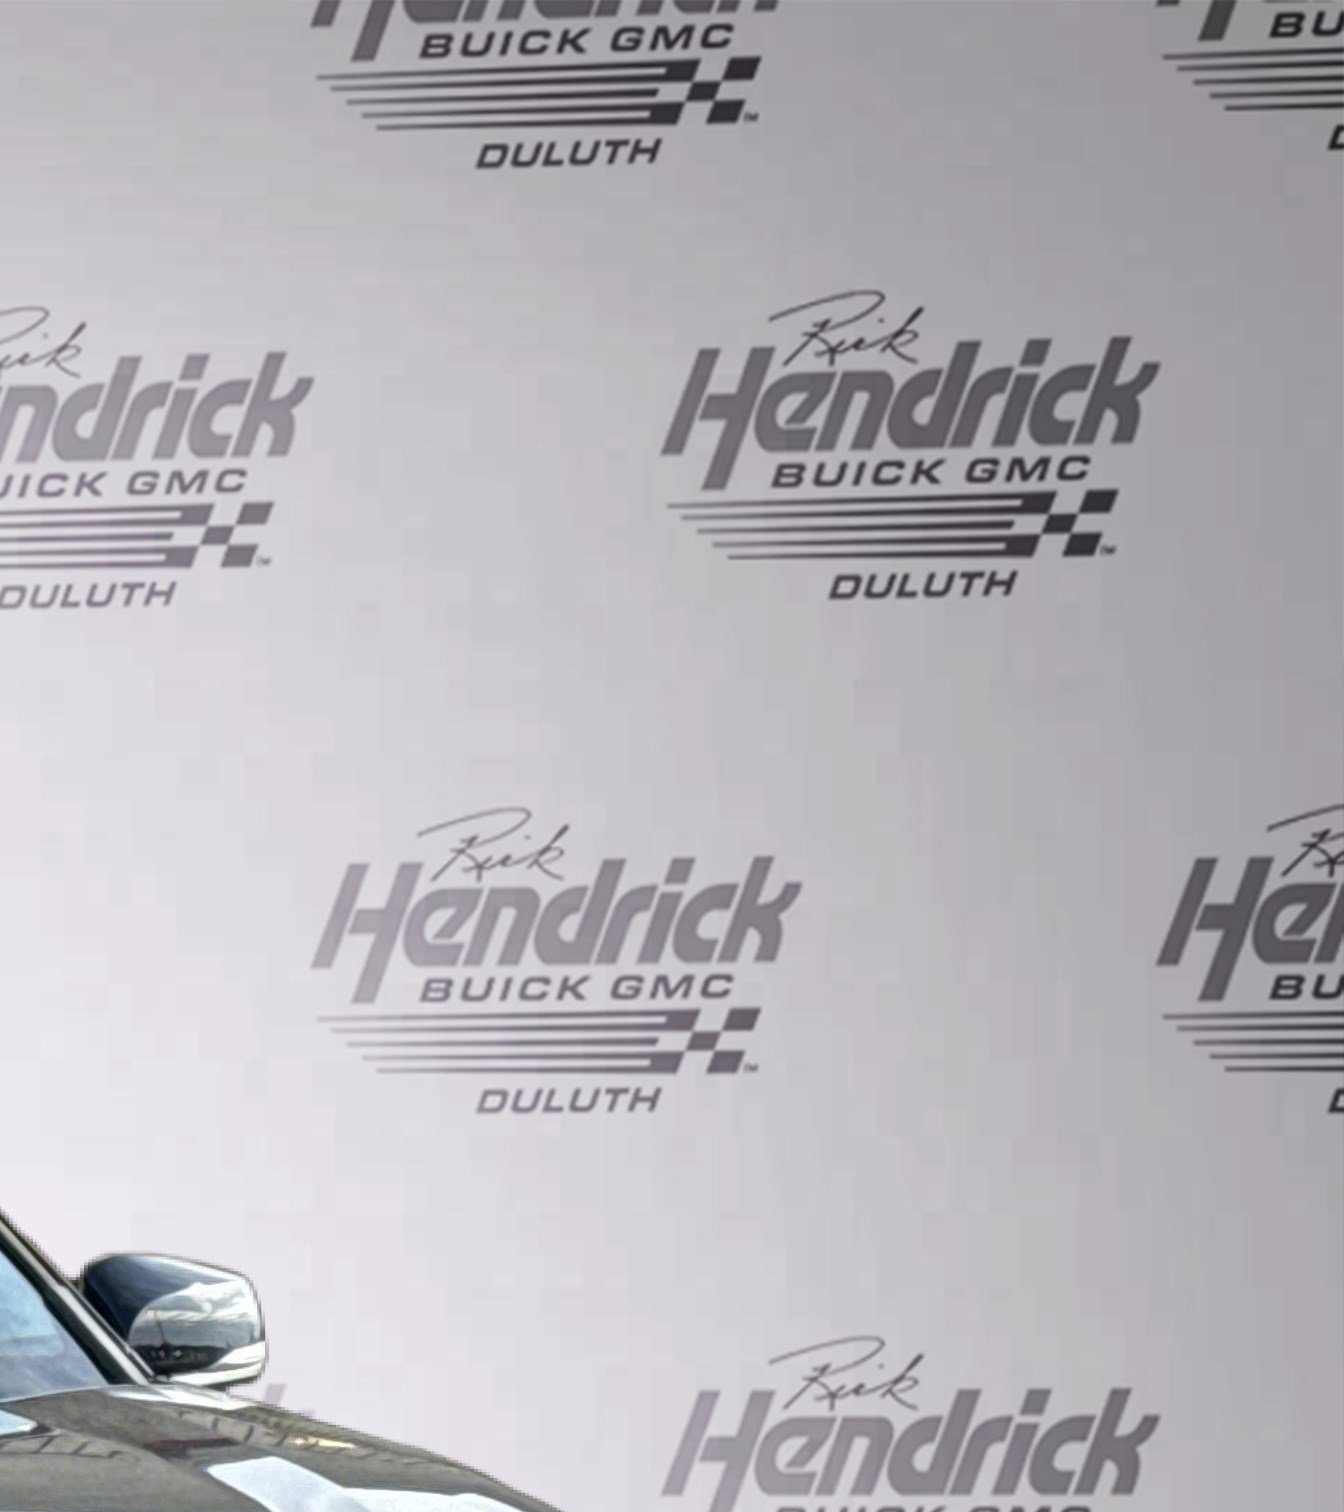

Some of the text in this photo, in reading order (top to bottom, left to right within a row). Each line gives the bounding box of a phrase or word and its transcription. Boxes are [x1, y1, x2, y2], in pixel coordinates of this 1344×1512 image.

[418, 28, 592, 60] BUICK
[609, 24, 735, 53] GMC
[475, 138, 663, 169] DULUTH
[660, 335, 1161, 492] Hendrick
[126, 468, 248, 496] GMC
[770, 455, 1092, 489] BUICK GMC
[828, 570, 1018, 601] DULUTH
[311, 855, 803, 1004] Hendrick
[419, 973, 735, 1003] BUICK GMC
[476, 1086, 663, 1114] DULUTH
